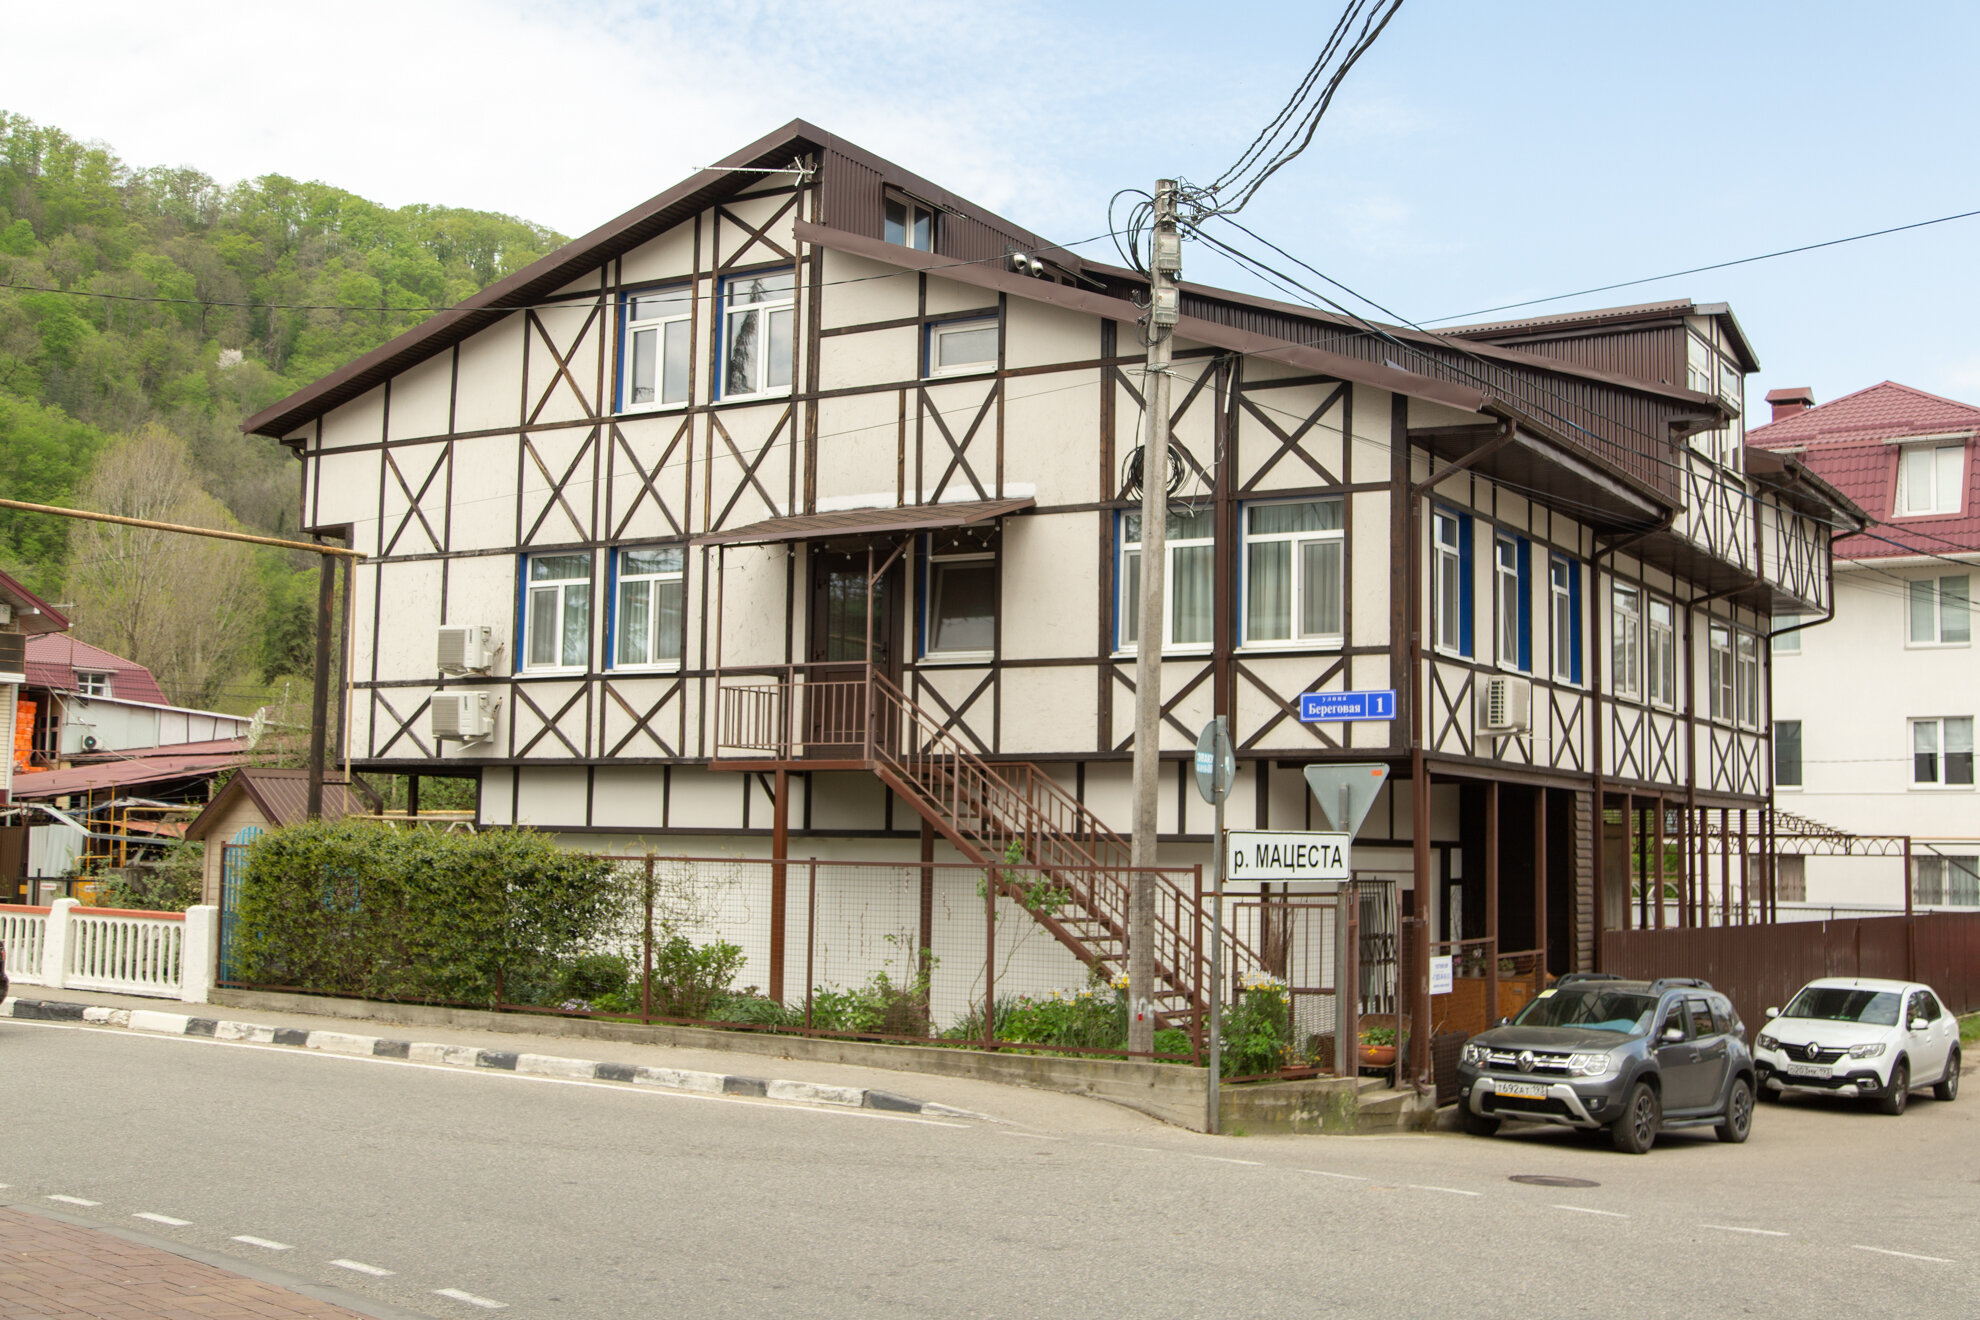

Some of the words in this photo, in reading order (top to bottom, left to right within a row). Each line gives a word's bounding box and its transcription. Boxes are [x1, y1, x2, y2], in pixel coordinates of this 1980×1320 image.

[1308, 703, 1361, 717] Береговая
[1376, 697, 1384, 713] 1
[1234, 850, 1249, 875] р.
[1256, 844, 1343, 873] МАЦЕСТА
